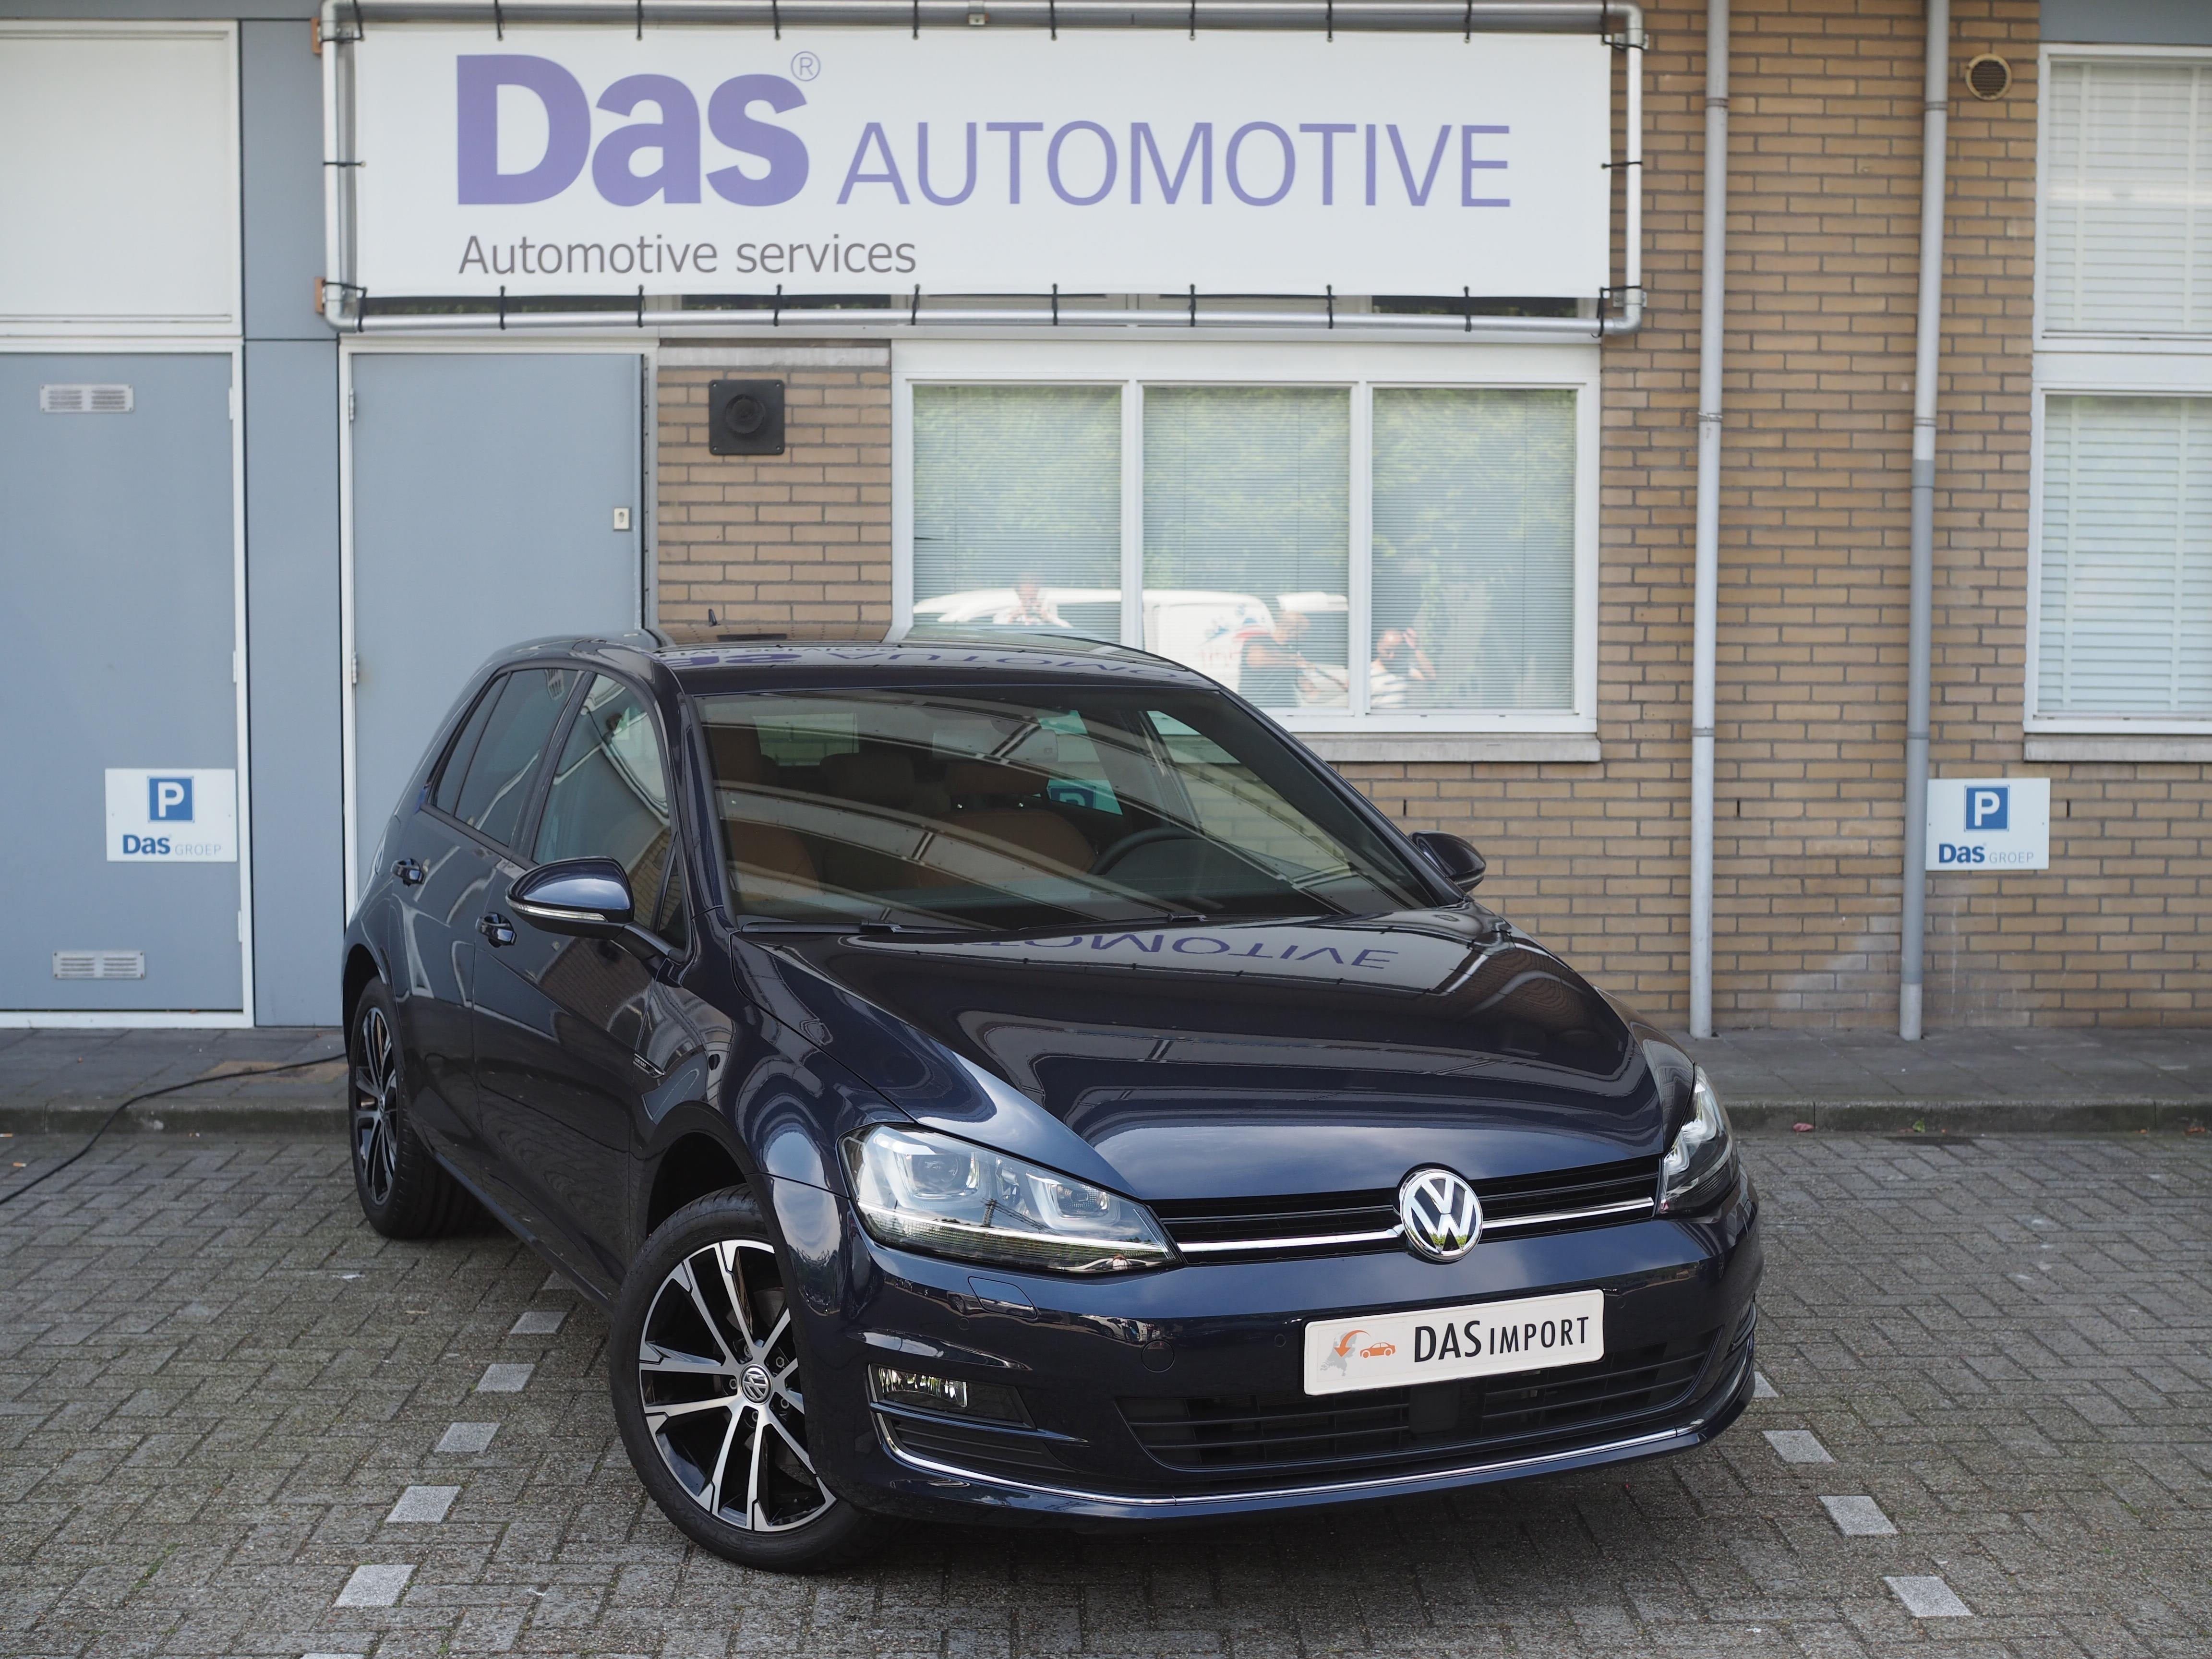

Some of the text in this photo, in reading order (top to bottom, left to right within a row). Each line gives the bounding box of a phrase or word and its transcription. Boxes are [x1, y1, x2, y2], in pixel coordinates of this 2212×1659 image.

[836, 120, 1511, 207] AUTOMOTIVE
[458, 234, 916, 275] Automotive services
[157, 781, 185, 818] P
[1974, 791, 2000, 827] P
[122, 834, 222, 856] Das GROEP
[1938, 842, 2034, 864] Das GROEP
[1414, 1316, 1589, 1363] DAS IMPORT
